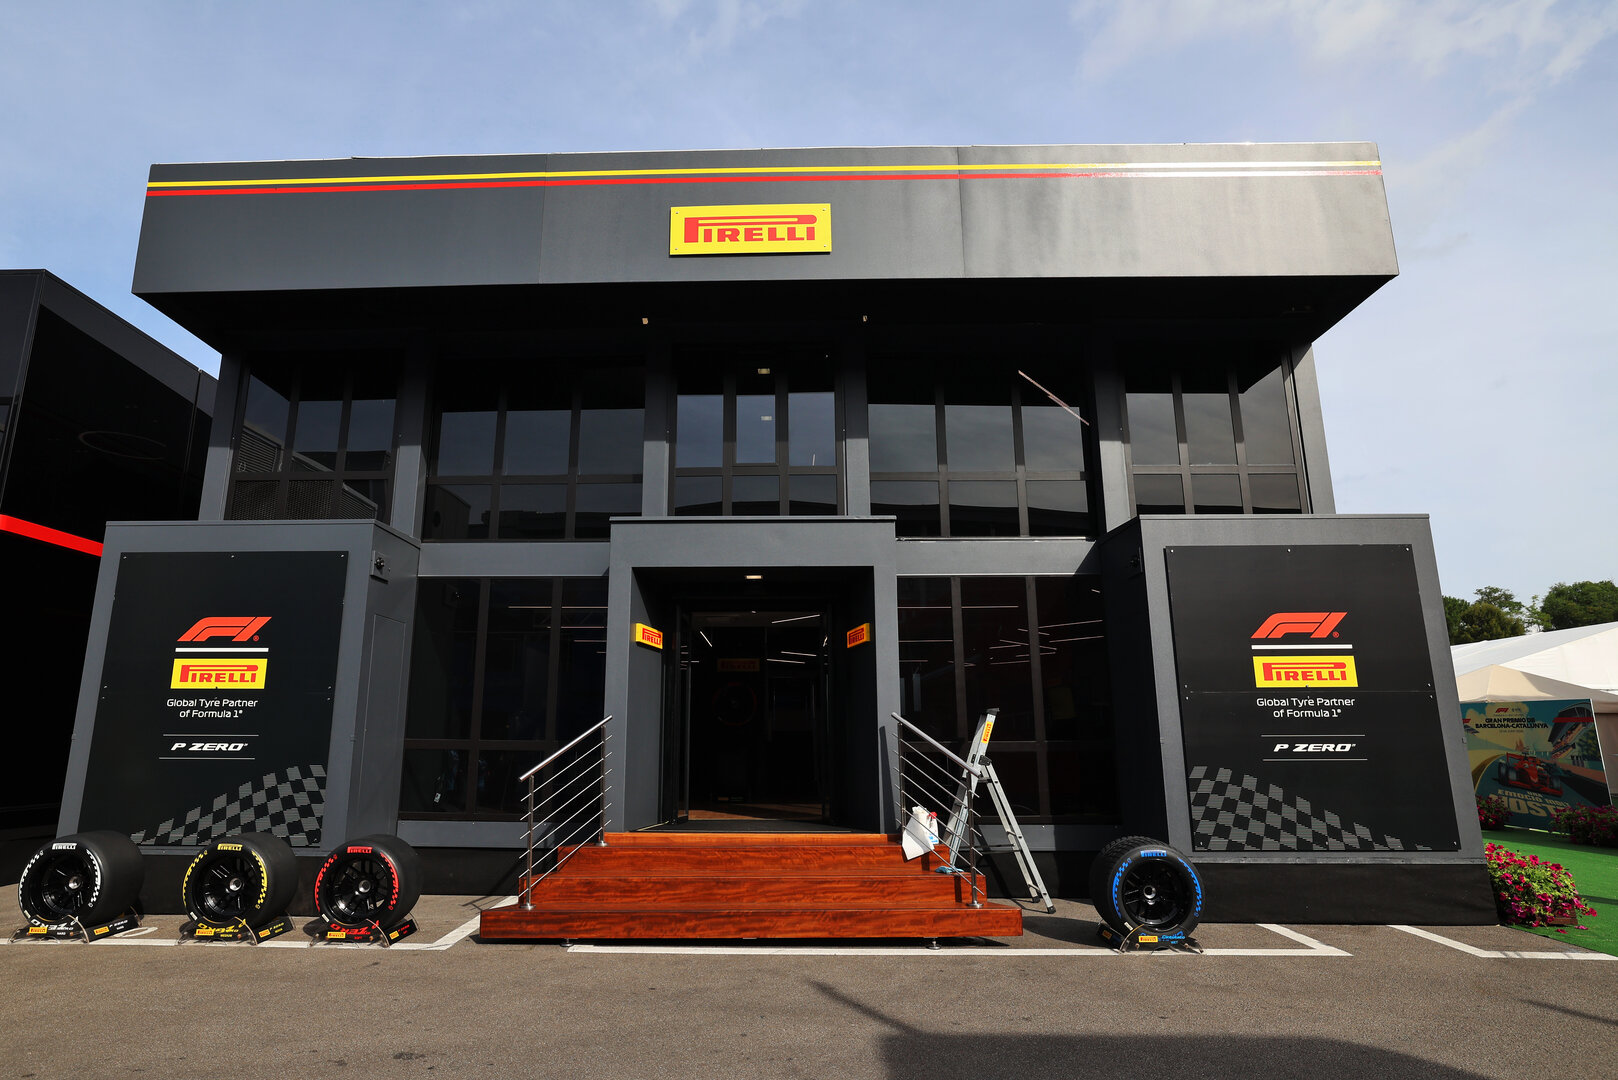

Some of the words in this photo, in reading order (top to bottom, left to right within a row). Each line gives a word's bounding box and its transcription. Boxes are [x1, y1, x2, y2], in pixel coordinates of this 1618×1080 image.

[684, 215, 817, 243] PIRELLI
[177, 616, 272, 641] F1
[1251, 612, 1348, 639] F1
[642, 628, 661, 646] PIRELLI
[848, 627, 865, 645] PIRELLI
[179, 664, 259, 683] PIRELLI
[1262, 662, 1347, 681] PIRELLI
[166, 698, 197, 707] Global
[199, 698, 221, 708] Tyre
[222, 698, 259, 707] Partner
[1256, 698, 1289, 707] Global
[1290, 697, 1315, 708] Tyre
[1316, 697, 1356, 707] Partner
[179, 710, 190, 718] of
[192, 709, 232, 718] Formula
[1273, 709, 1285, 718] of
[1286, 709, 1330, 718] Formula
[170, 742, 187, 751] P
[1273, 743, 1289, 752] P
[217, 843, 243, 851] PIRELLI
[347, 846, 373, 854] PIRELLI
